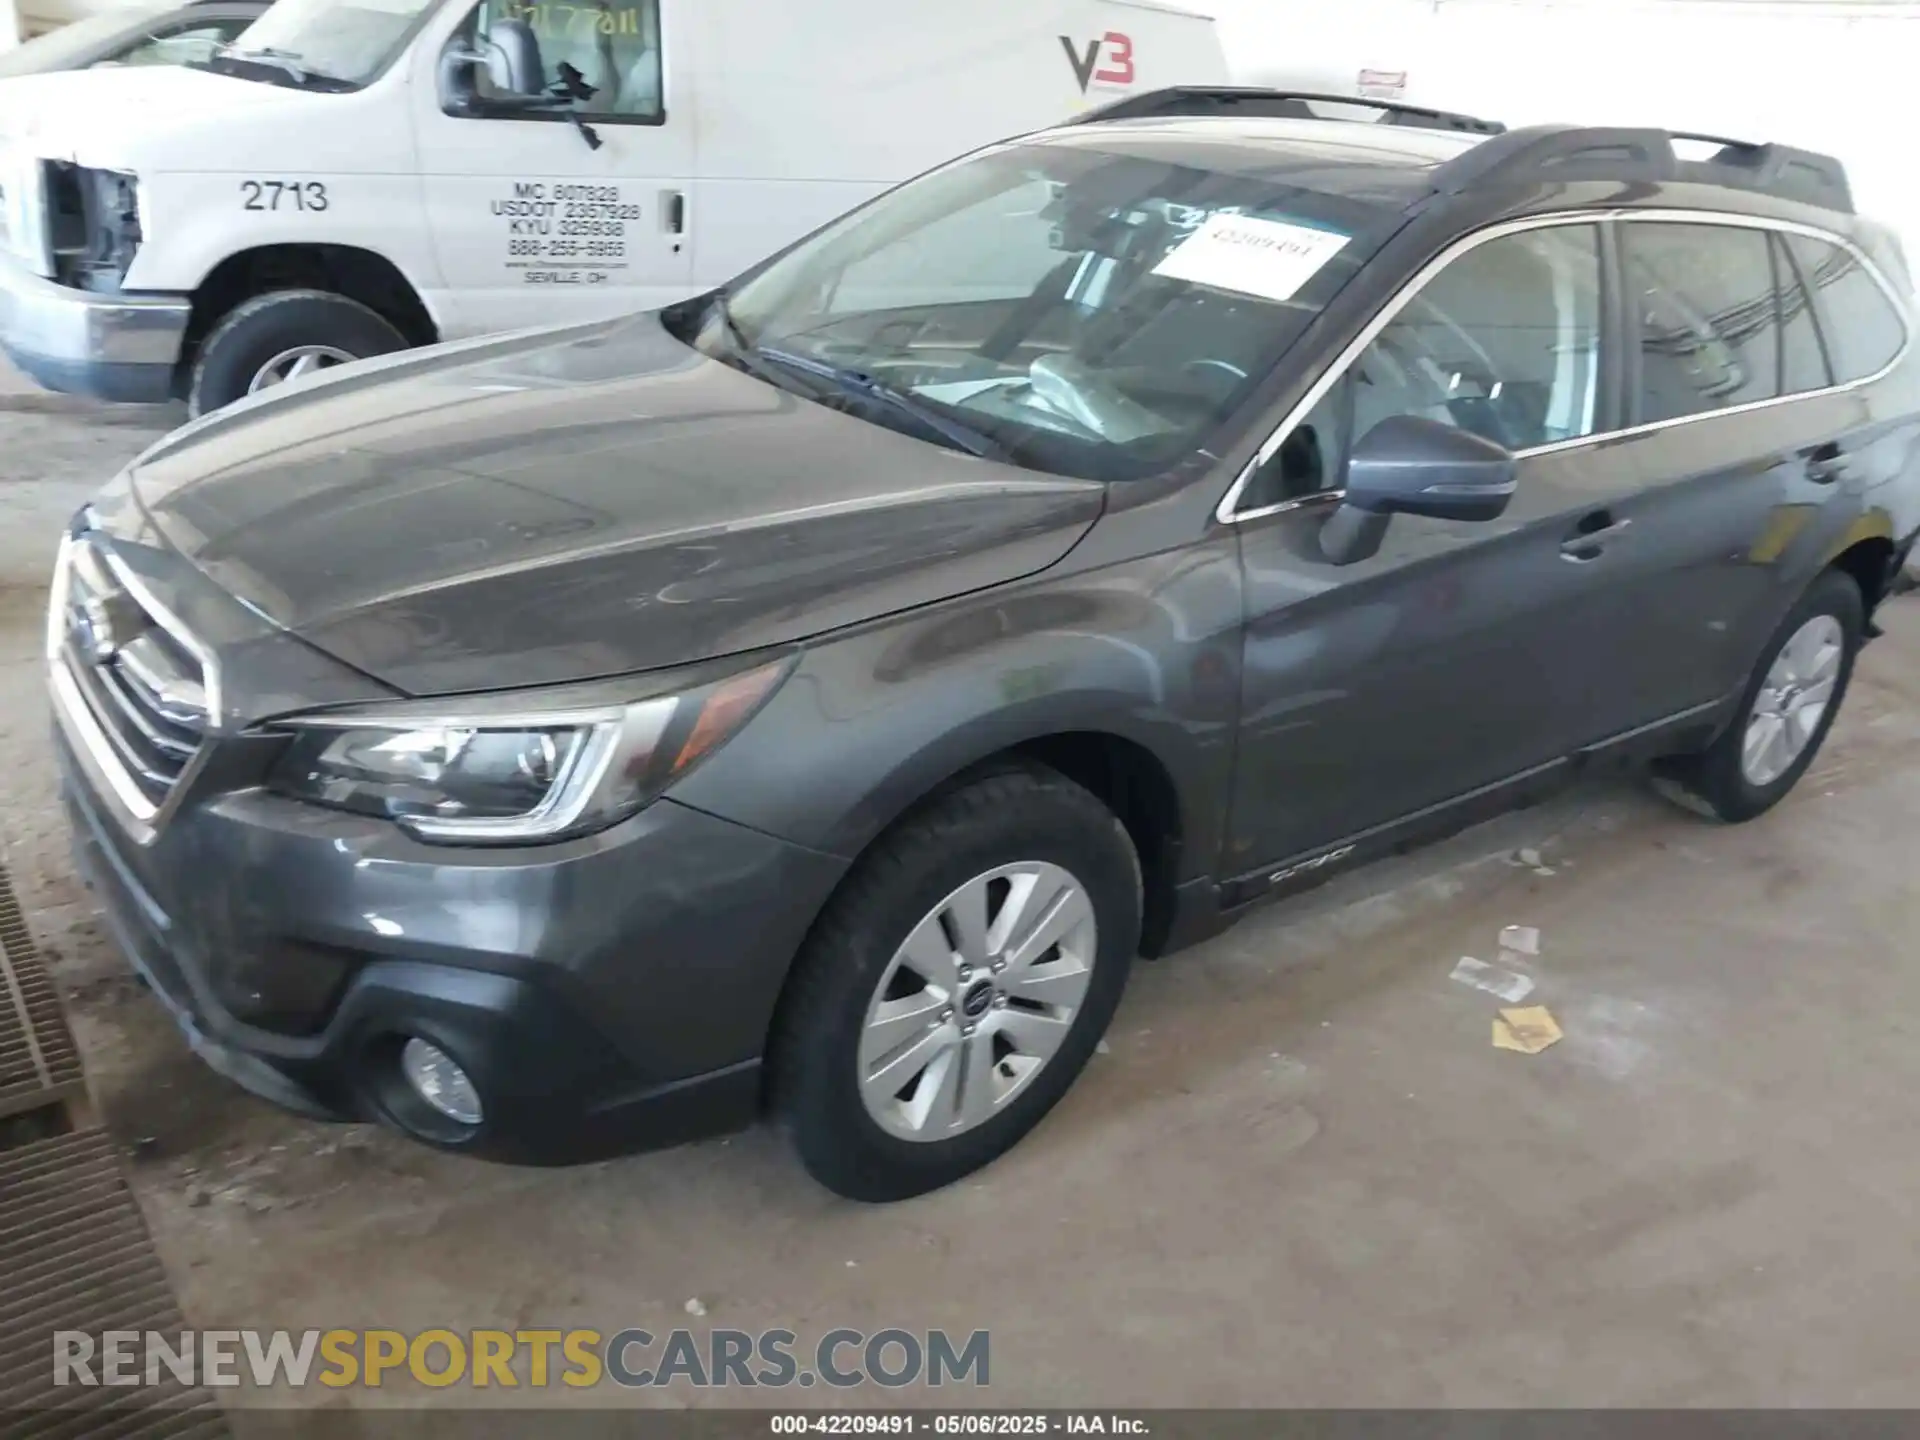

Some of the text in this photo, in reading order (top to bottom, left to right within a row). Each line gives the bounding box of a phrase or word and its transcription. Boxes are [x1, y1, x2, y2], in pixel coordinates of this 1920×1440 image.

[1058, 31, 1134, 94] V3
[241, 180, 328, 211] 2713
[514, 182, 546, 199] MC
[491, 200, 557, 217] USDOT
[509, 219, 551, 235] KYU
